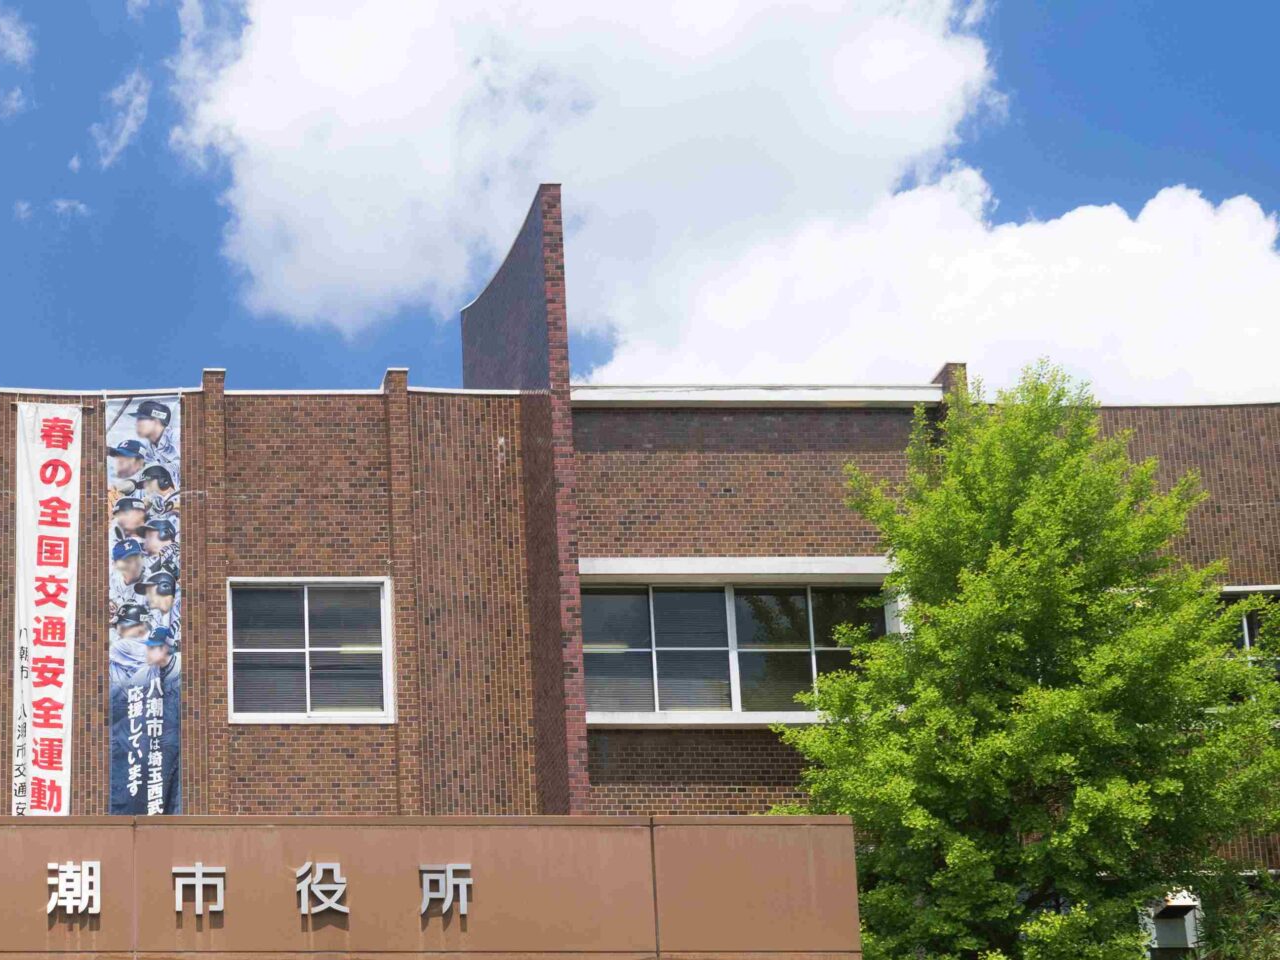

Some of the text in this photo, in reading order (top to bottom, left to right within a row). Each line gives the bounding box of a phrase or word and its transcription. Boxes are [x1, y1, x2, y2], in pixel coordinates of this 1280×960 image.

[29, 417, 74, 813] 春の全国交通安全運動
[126, 685, 144, 797] 応援しています
[145, 677, 164, 815] 八潮市は埼玉西武
